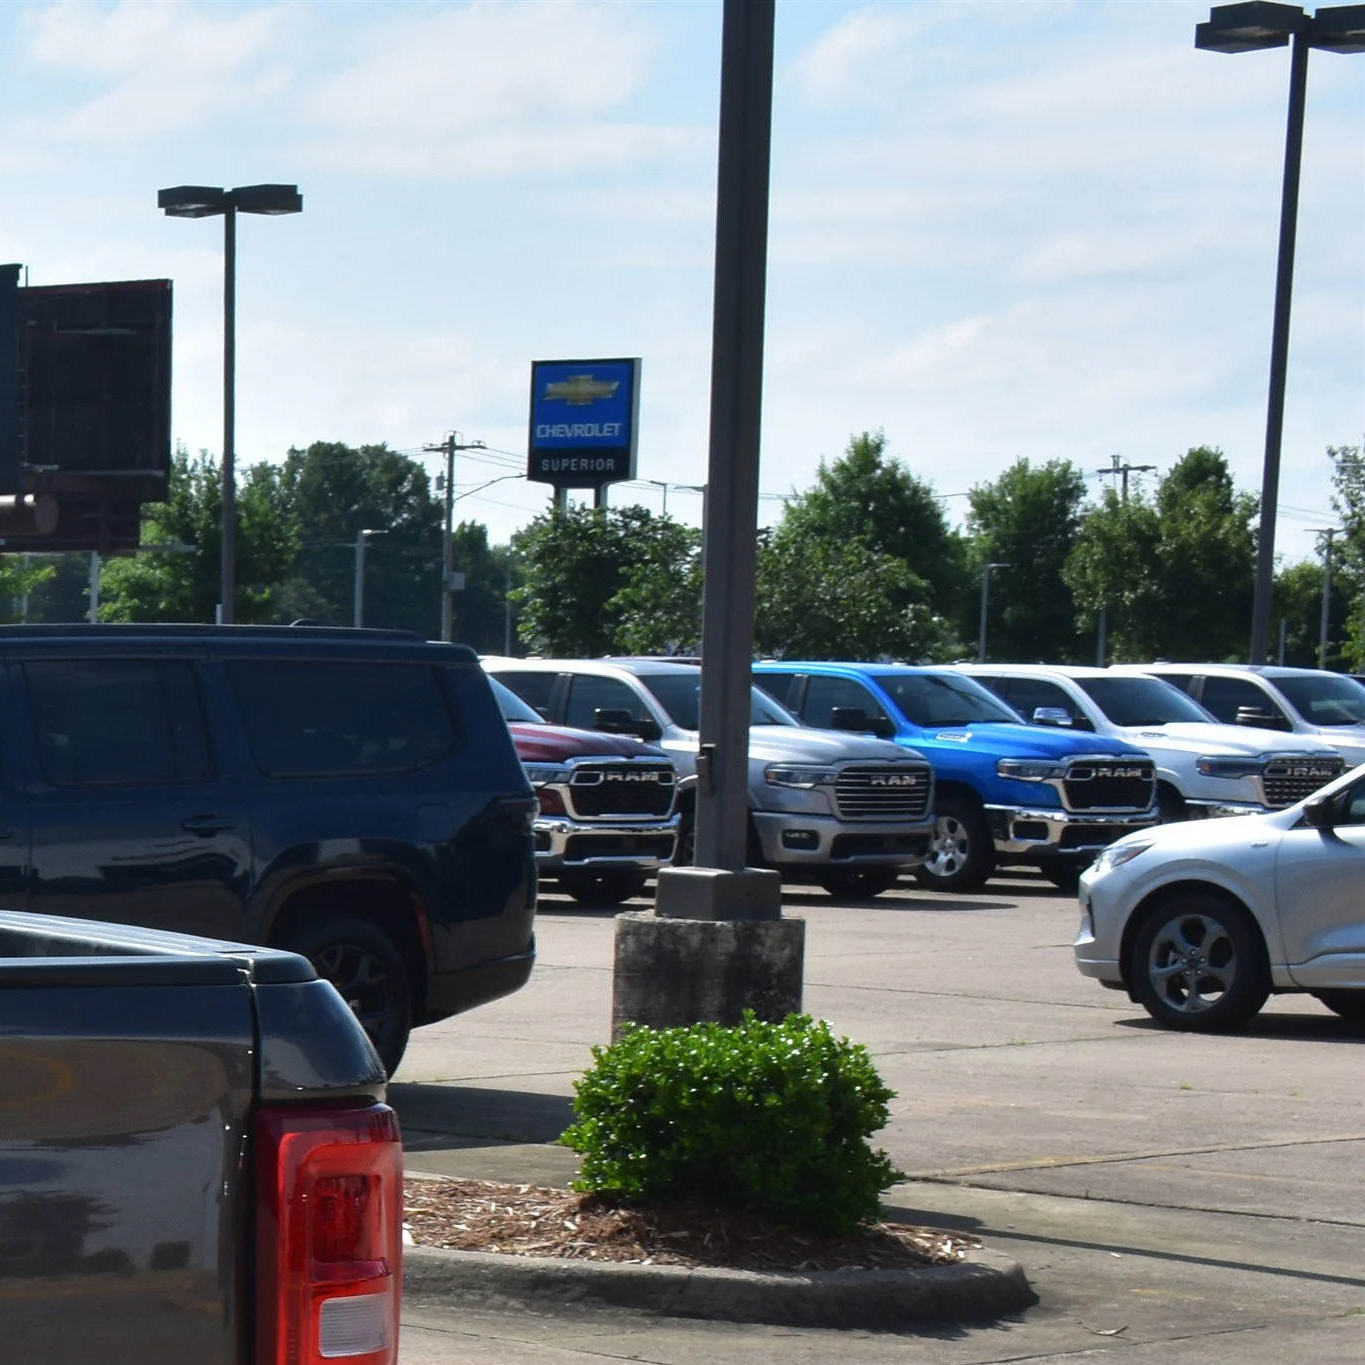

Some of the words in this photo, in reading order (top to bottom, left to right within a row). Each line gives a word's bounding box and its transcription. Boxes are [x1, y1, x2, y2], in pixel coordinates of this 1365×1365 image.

[537, 423, 620, 437] CHEVROLET
[542, 458, 615, 471] SUPERIOR
[607, 771, 659, 781] RAM
[1097, 768, 1142, 778] RAM
[1293, 766, 1333, 776] RAM
[871, 775, 916, 785] RAM
